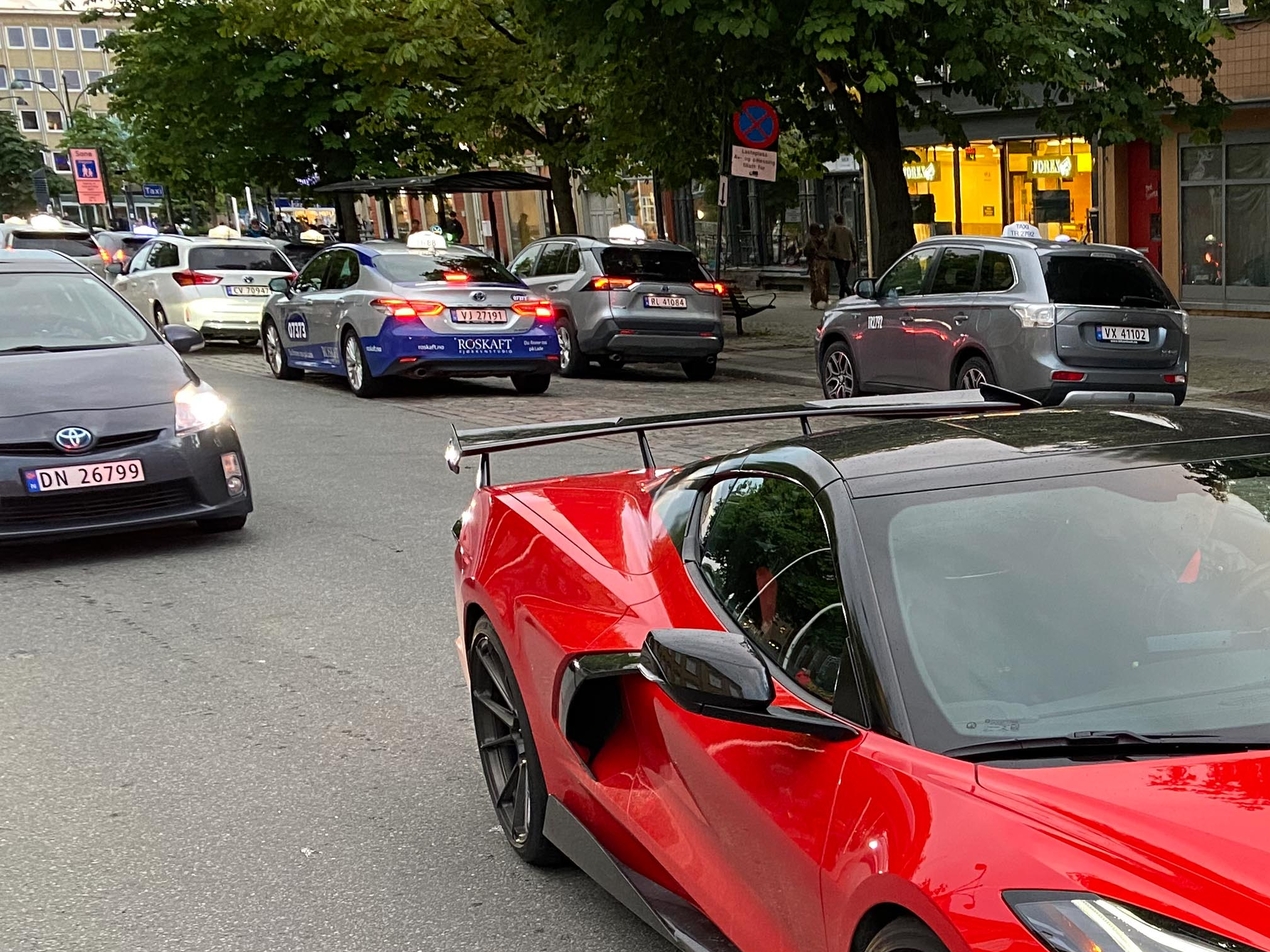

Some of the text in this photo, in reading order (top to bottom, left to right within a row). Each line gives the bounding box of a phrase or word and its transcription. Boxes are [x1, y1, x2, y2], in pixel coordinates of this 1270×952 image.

[144, 187, 163, 195] Taxi
[651, 297, 684, 307] RL 41084
[461, 311, 502, 320] VJ 27191
[287, 322, 307, 339] 07373
[1104, 328, 1146, 340] VX 41102
[39, 463, 140, 488] DN 26799
